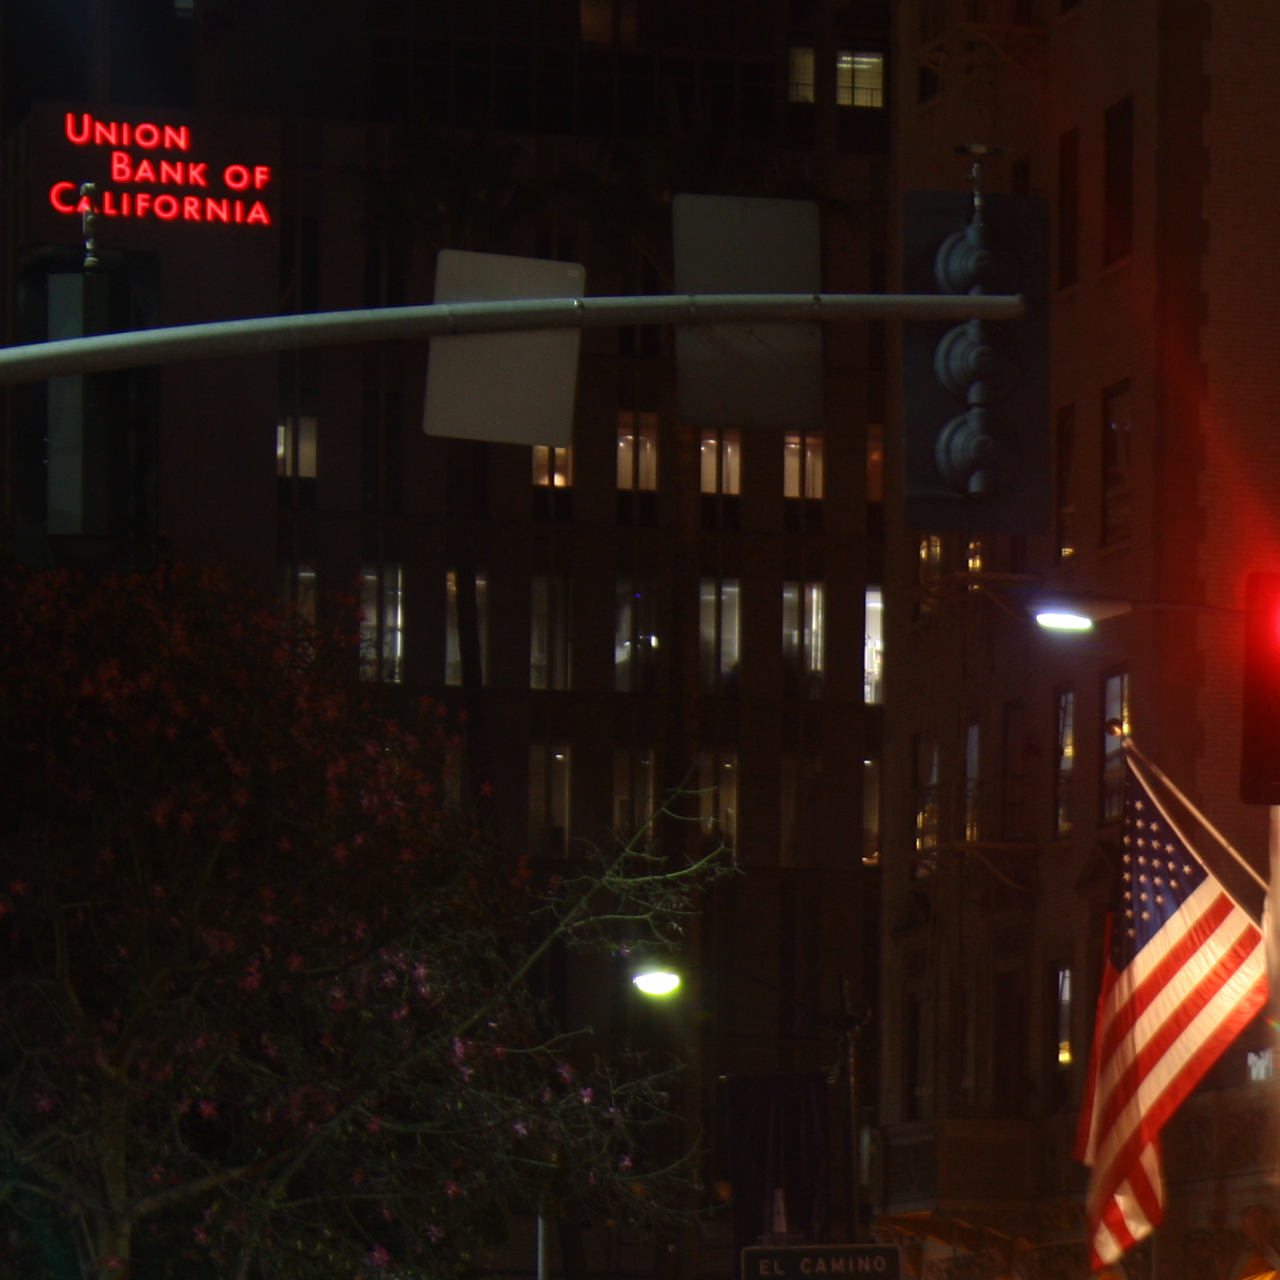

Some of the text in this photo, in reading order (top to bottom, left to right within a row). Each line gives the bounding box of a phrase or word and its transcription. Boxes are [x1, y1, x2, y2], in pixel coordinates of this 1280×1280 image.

[65, 112, 190, 150] UNION
[111, 151, 271, 189] BANK OF
[759, 1255, 886, 1276] EL CAMINO
